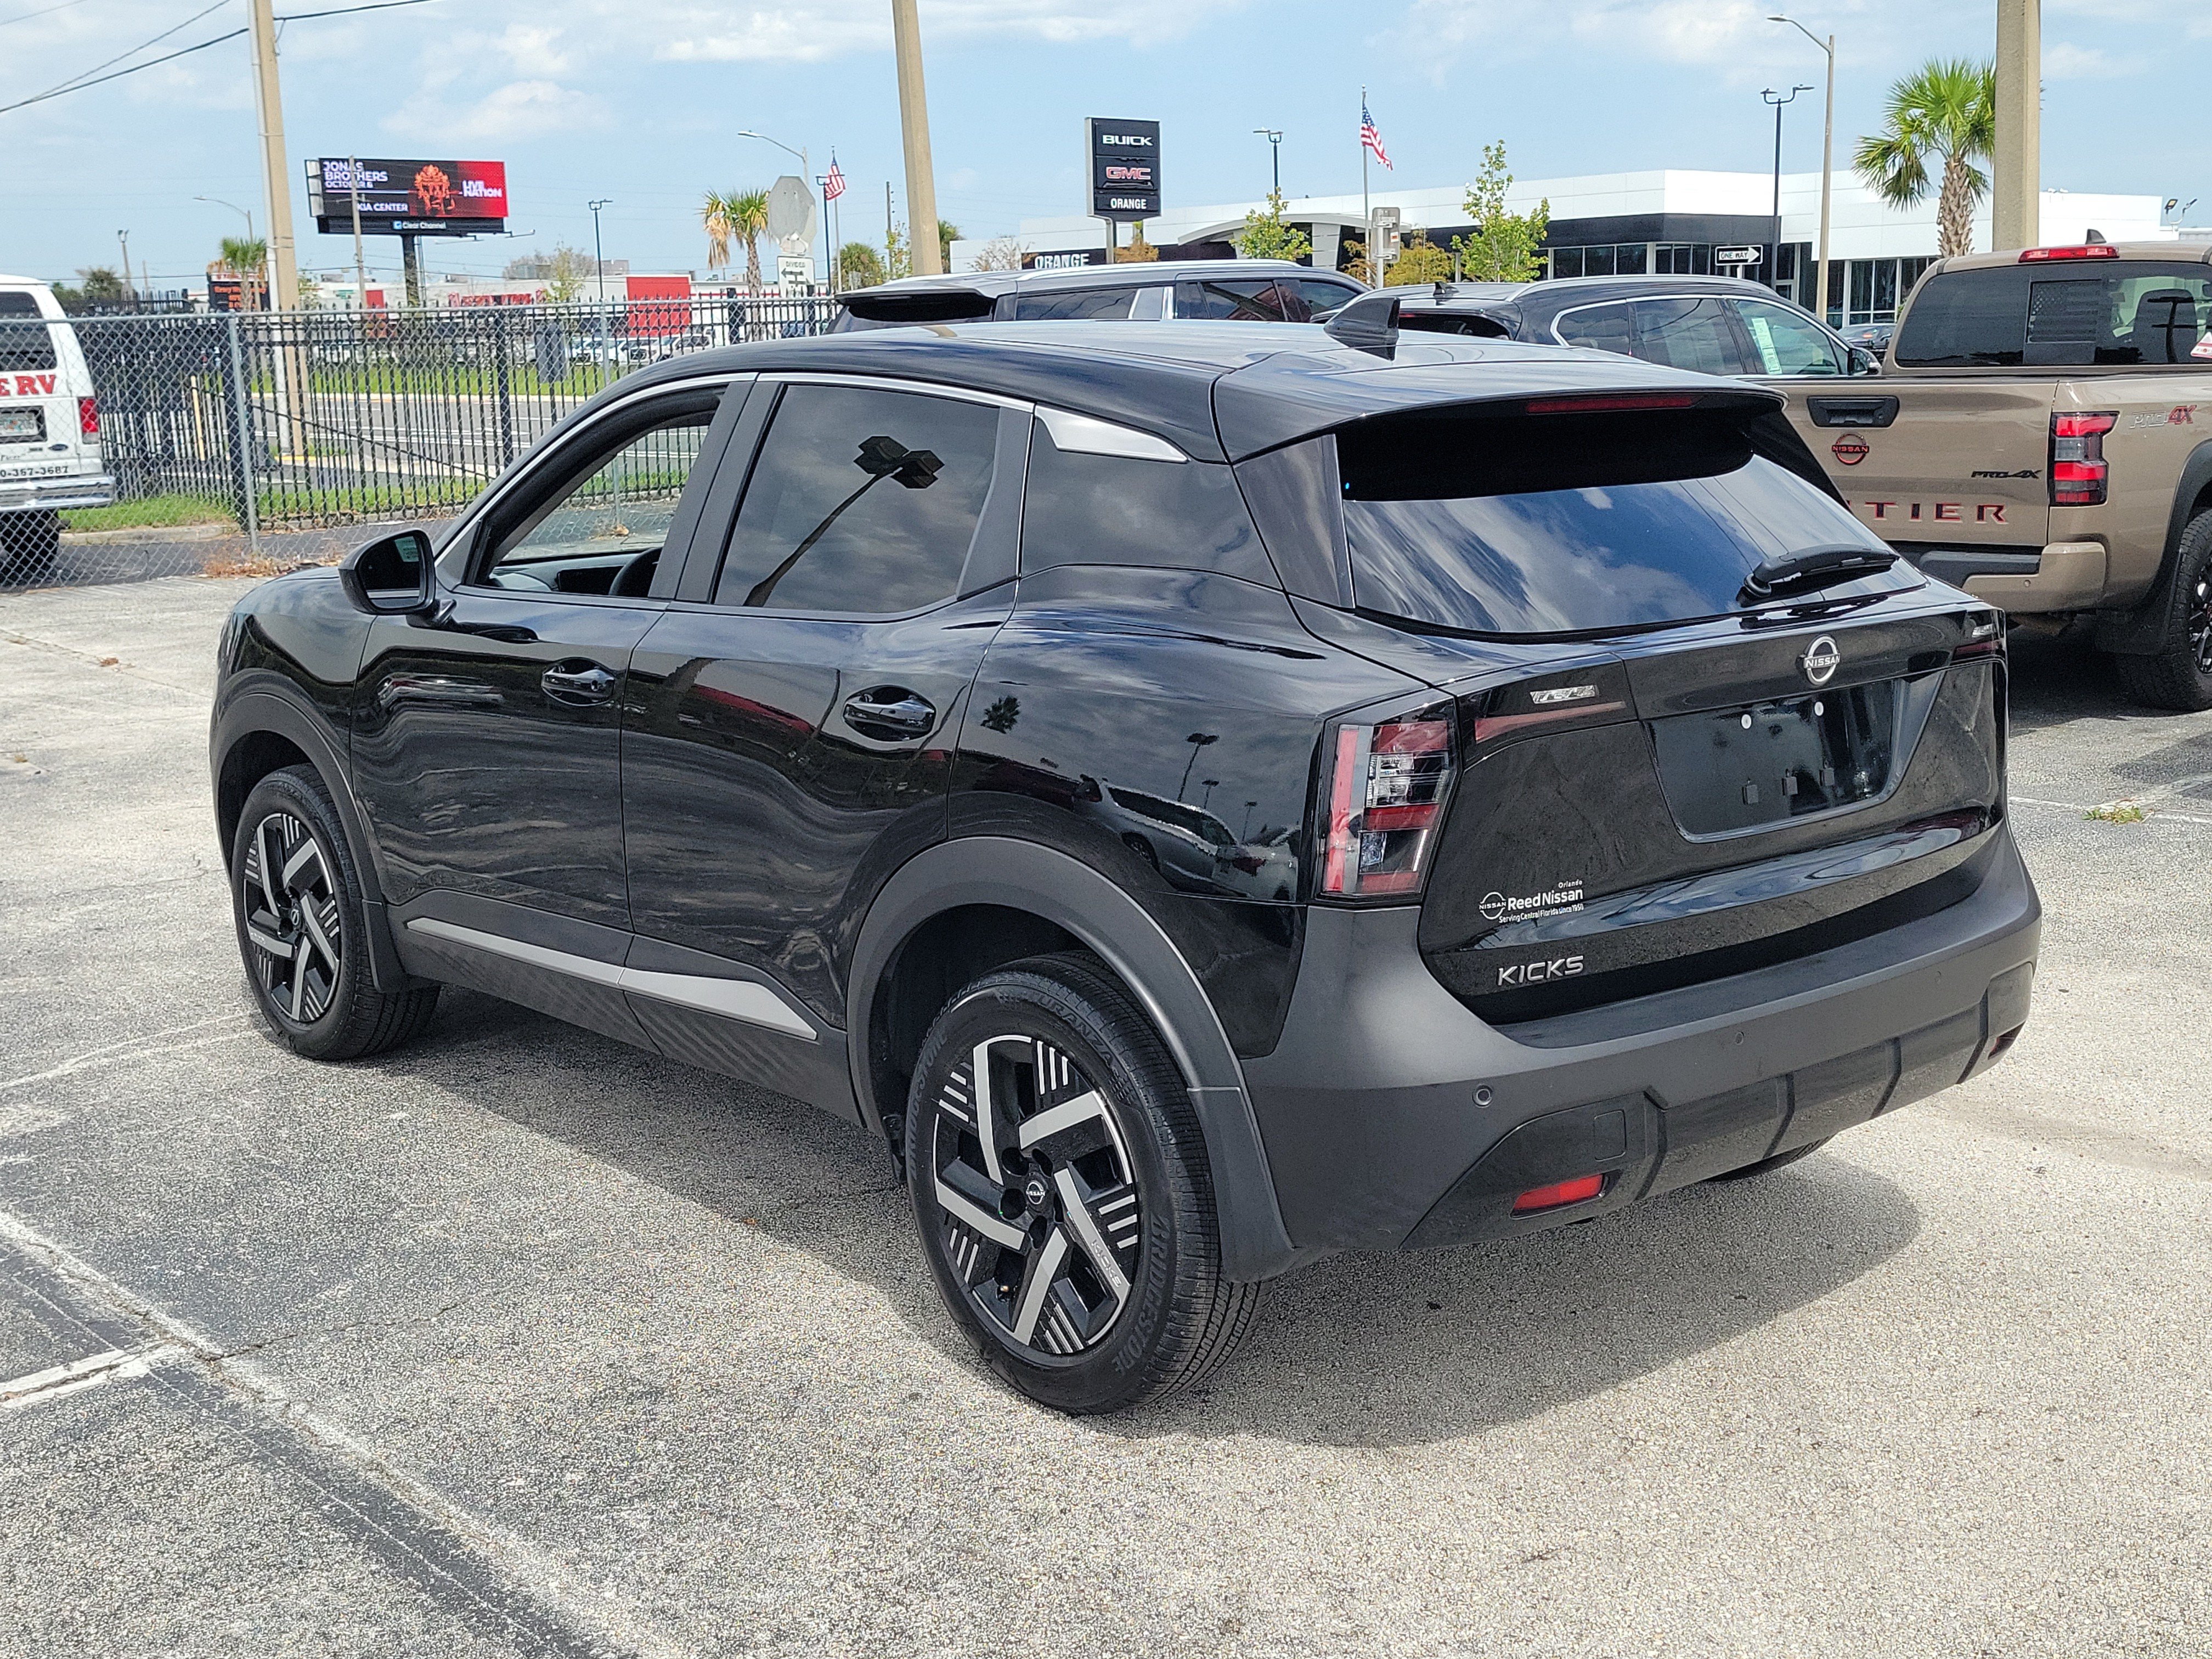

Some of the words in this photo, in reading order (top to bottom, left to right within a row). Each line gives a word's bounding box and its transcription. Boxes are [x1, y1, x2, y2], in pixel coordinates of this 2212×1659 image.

[1103, 135, 1153, 146] BUICK
[323, 160, 364, 172] JONS
[1106, 167, 1151, 179] GMC
[463, 188, 502, 197] NATION
[373, 202, 409, 212] CENTER
[1110, 198, 1147, 209] ORANGE
[1034, 253, 1090, 269] ORANGE
[15, 374, 56, 395] RV
[1847, 500, 2008, 524] TIER
[1805, 655, 1840, 668] NISSAN
[1558, 879, 1583, 888] Orlando
[1479, 901, 1506, 910] NISSAN
[1508, 893, 1541, 911] Reed
[1542, 889, 1583, 905] Nissan
[1499, 914, 1520, 923] Serving
[1521, 910, 1540, 920] Central
[1540, 907, 1559, 917] Florida
[1572, 903, 1584, 912] 1950
[1498, 955, 1583, 986] KICKS
[1091, 1240, 1121, 1288] KICKS
